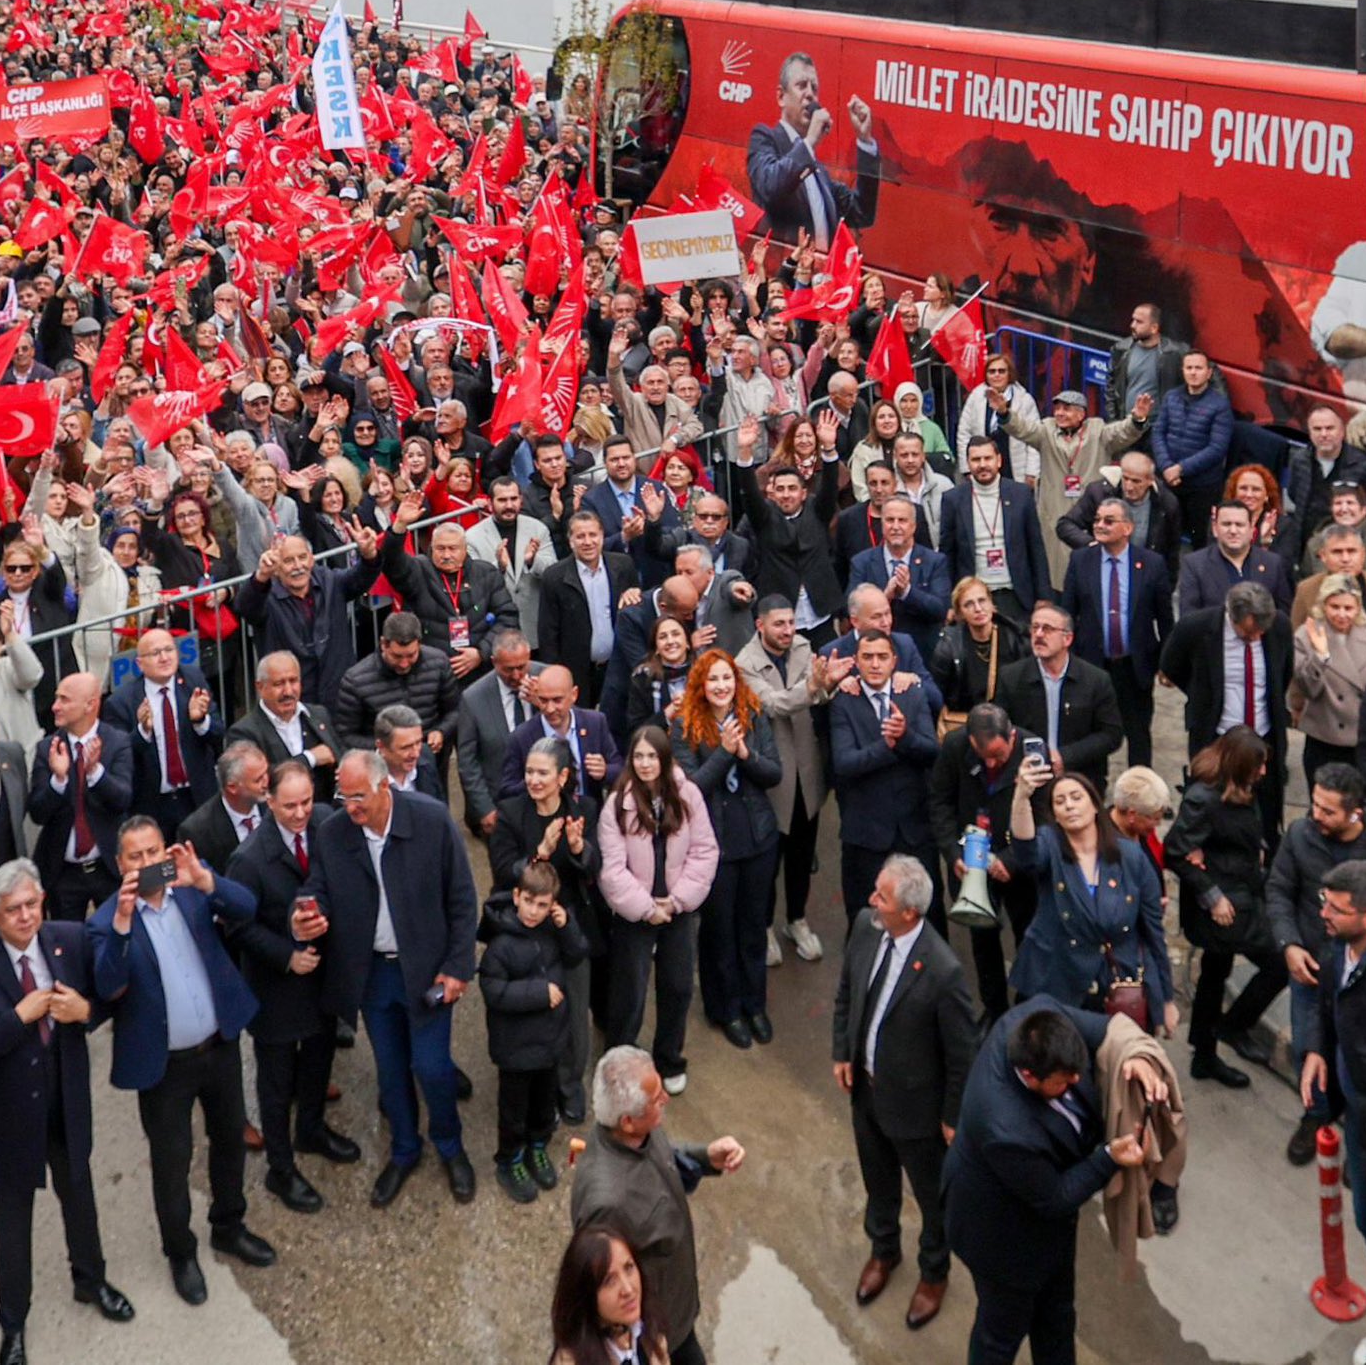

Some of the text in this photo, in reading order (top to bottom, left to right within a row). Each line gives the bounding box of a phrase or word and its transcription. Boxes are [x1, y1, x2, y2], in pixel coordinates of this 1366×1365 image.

[7, 86, 44, 104] CHP
[718, 80, 753, 104] CHP
[1, 103, 28, 121] İLÇE
[31, 93, 103, 116] BAŞKANLIĞI
[874, 60, 1354, 179] MİLLET İRADESİNE SAHİP ÇIKIYOR
[541, 392, 563, 432] CHP
